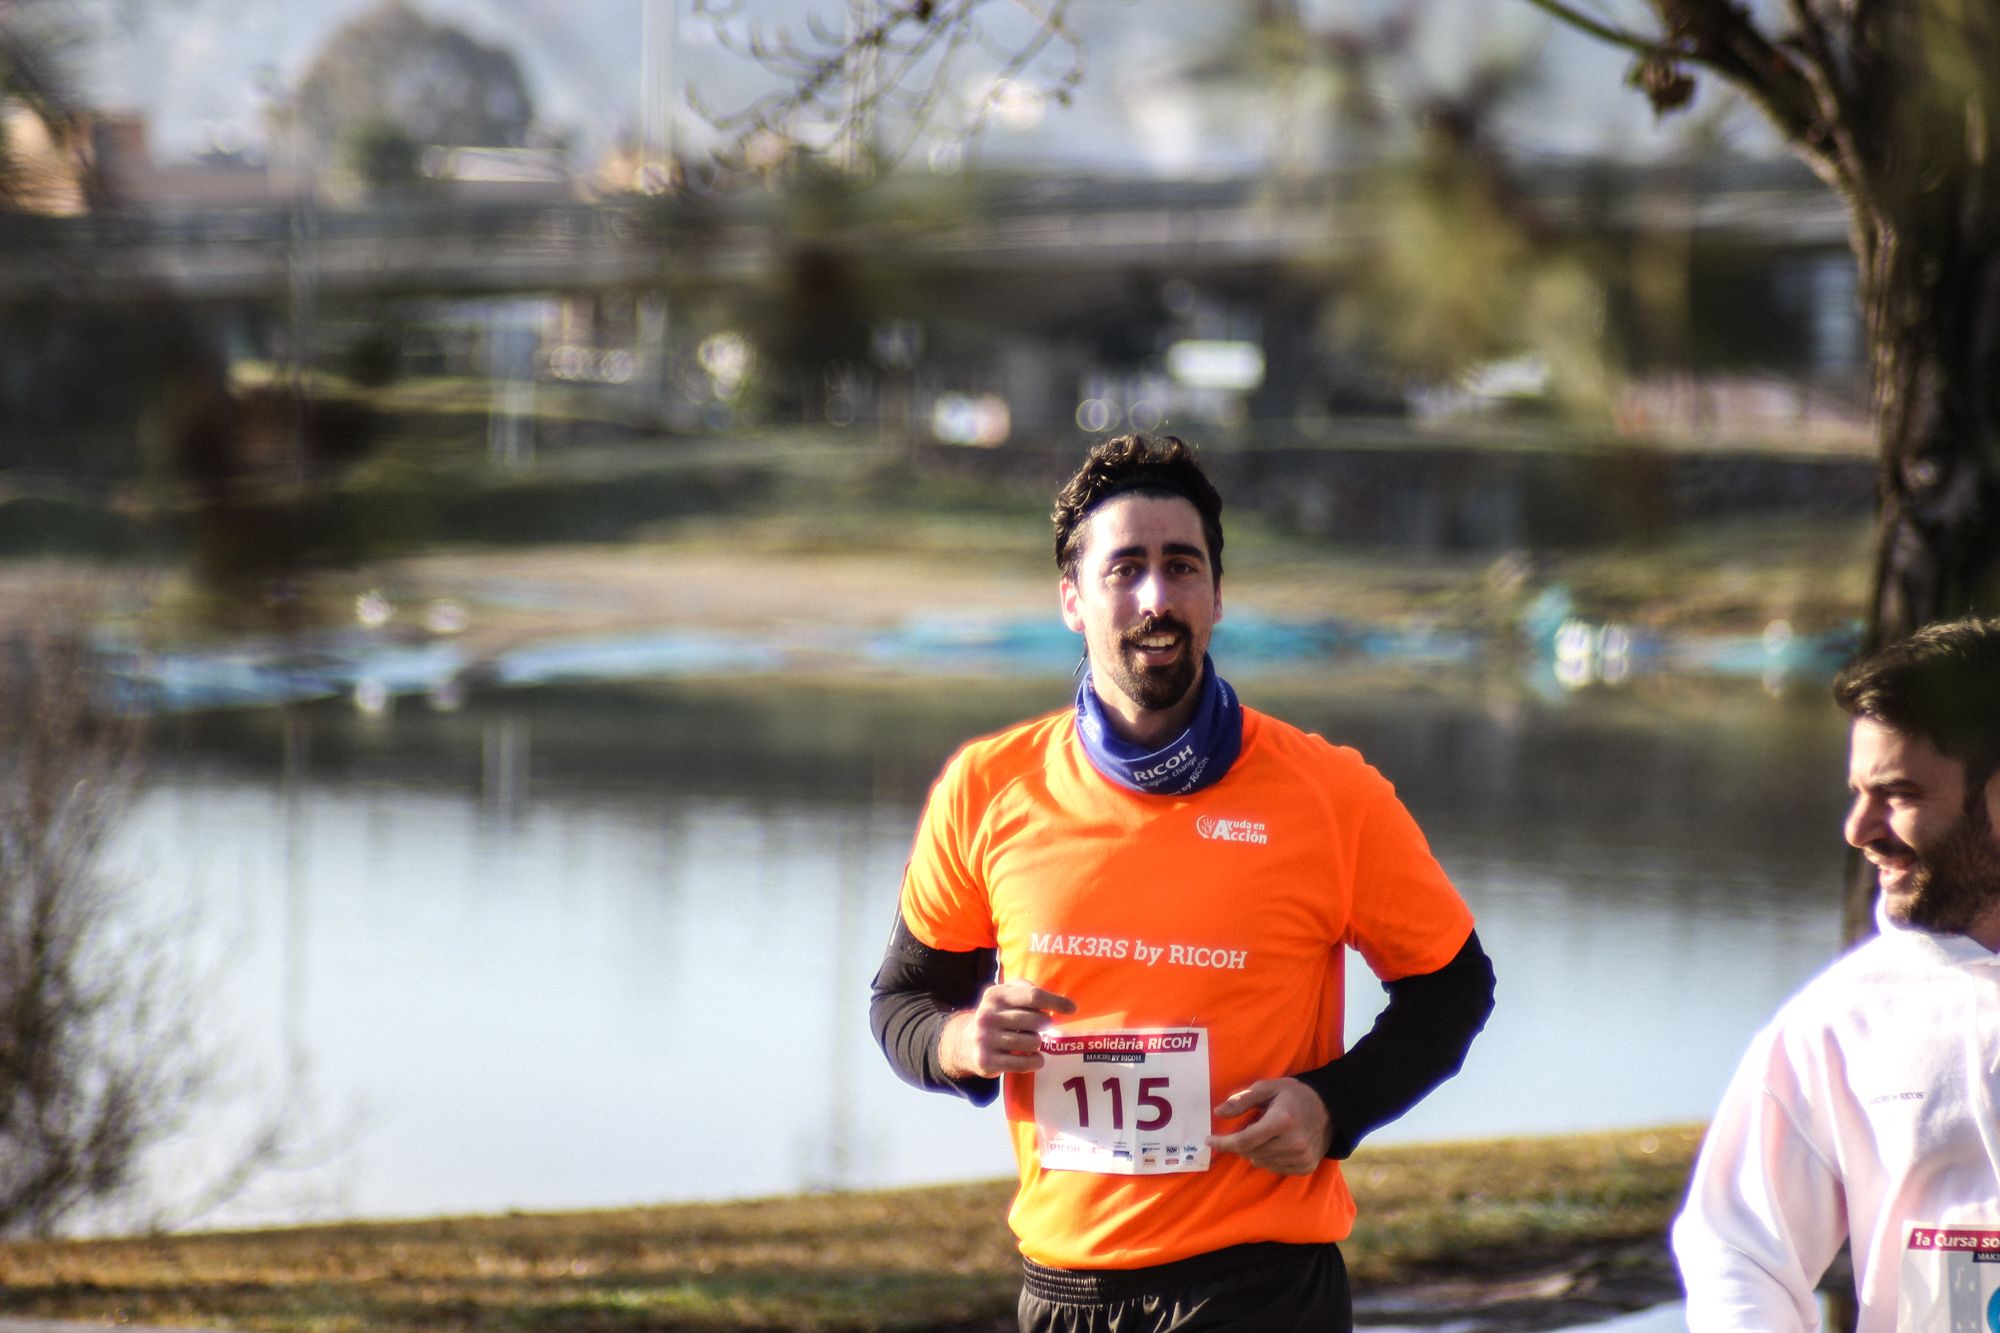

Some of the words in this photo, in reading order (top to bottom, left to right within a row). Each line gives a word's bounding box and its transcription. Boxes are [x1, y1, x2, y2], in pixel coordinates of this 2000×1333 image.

[1133, 744, 1193, 781] RICOH
[1029, 932, 1129, 959] MAK3RS
[1133, 939, 1164, 966] by
[1168, 944, 1248, 969] RICOH
[1050, 1040, 1084, 1051] Cursa
[1088, 1037, 1143, 1050] solidària
[1147, 1036, 1193, 1049] RICOH
[1062, 1076, 1173, 1131] 115
[1915, 1231, 1931, 1246] 1a
[1934, 1233, 1977, 1248] Cursa
